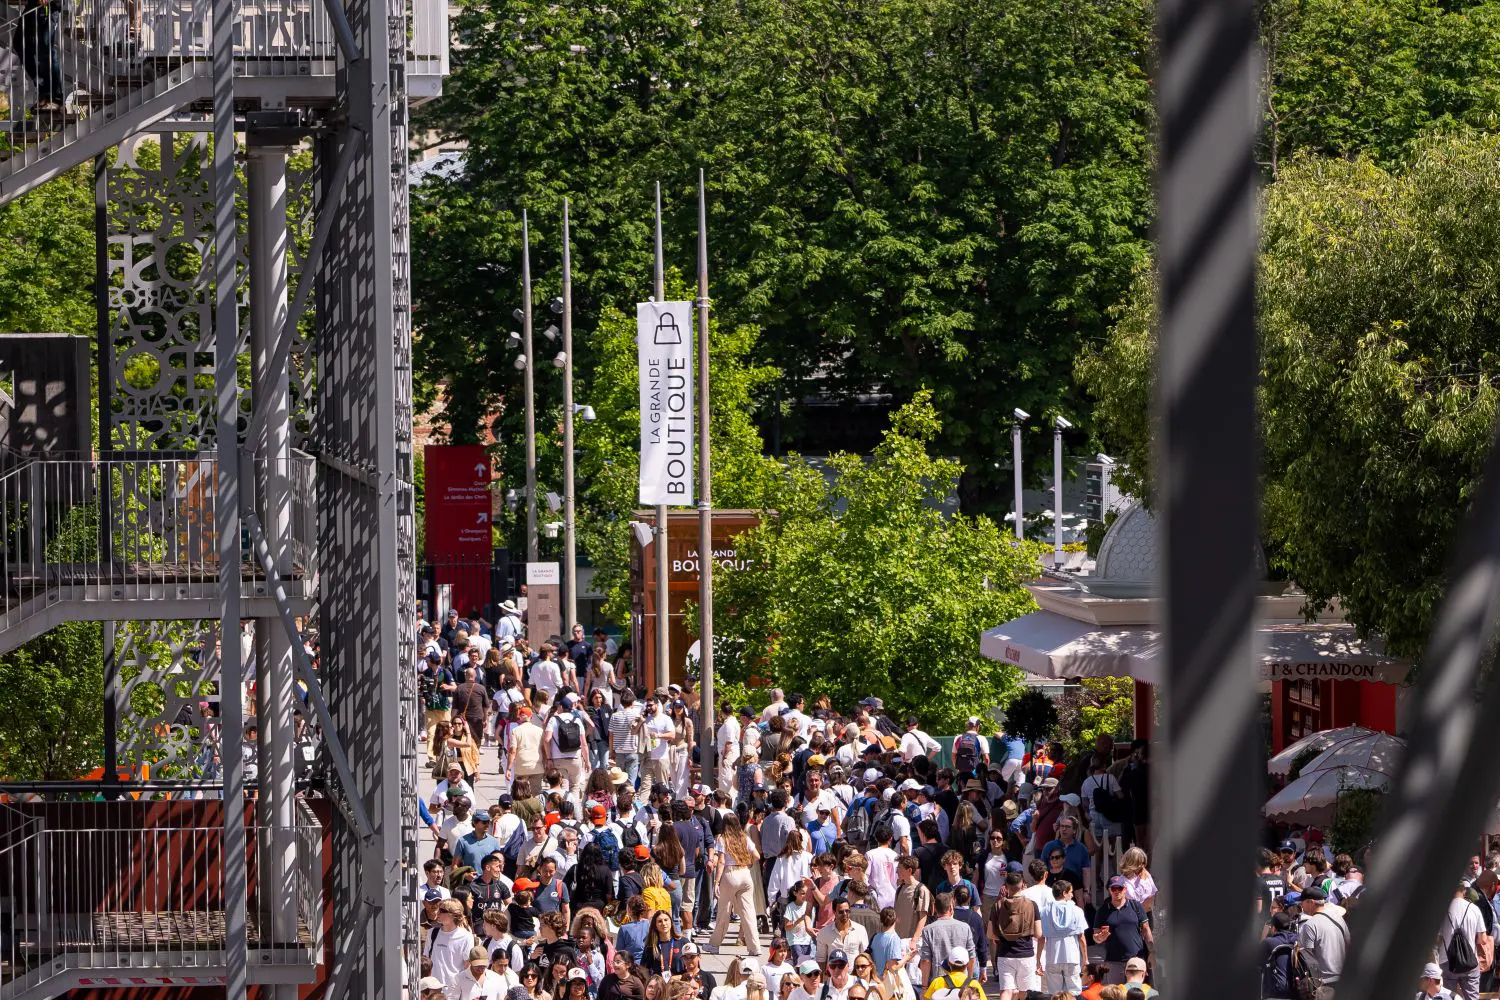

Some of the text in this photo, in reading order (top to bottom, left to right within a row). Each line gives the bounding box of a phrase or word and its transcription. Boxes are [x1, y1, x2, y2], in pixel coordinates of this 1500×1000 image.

[649, 358, 661, 444] LA GRANDE
[667, 357, 685, 494] BOUTIQUE
[1282, 664, 1293, 676] &
[1296, 663, 1375, 676] CHANDON
